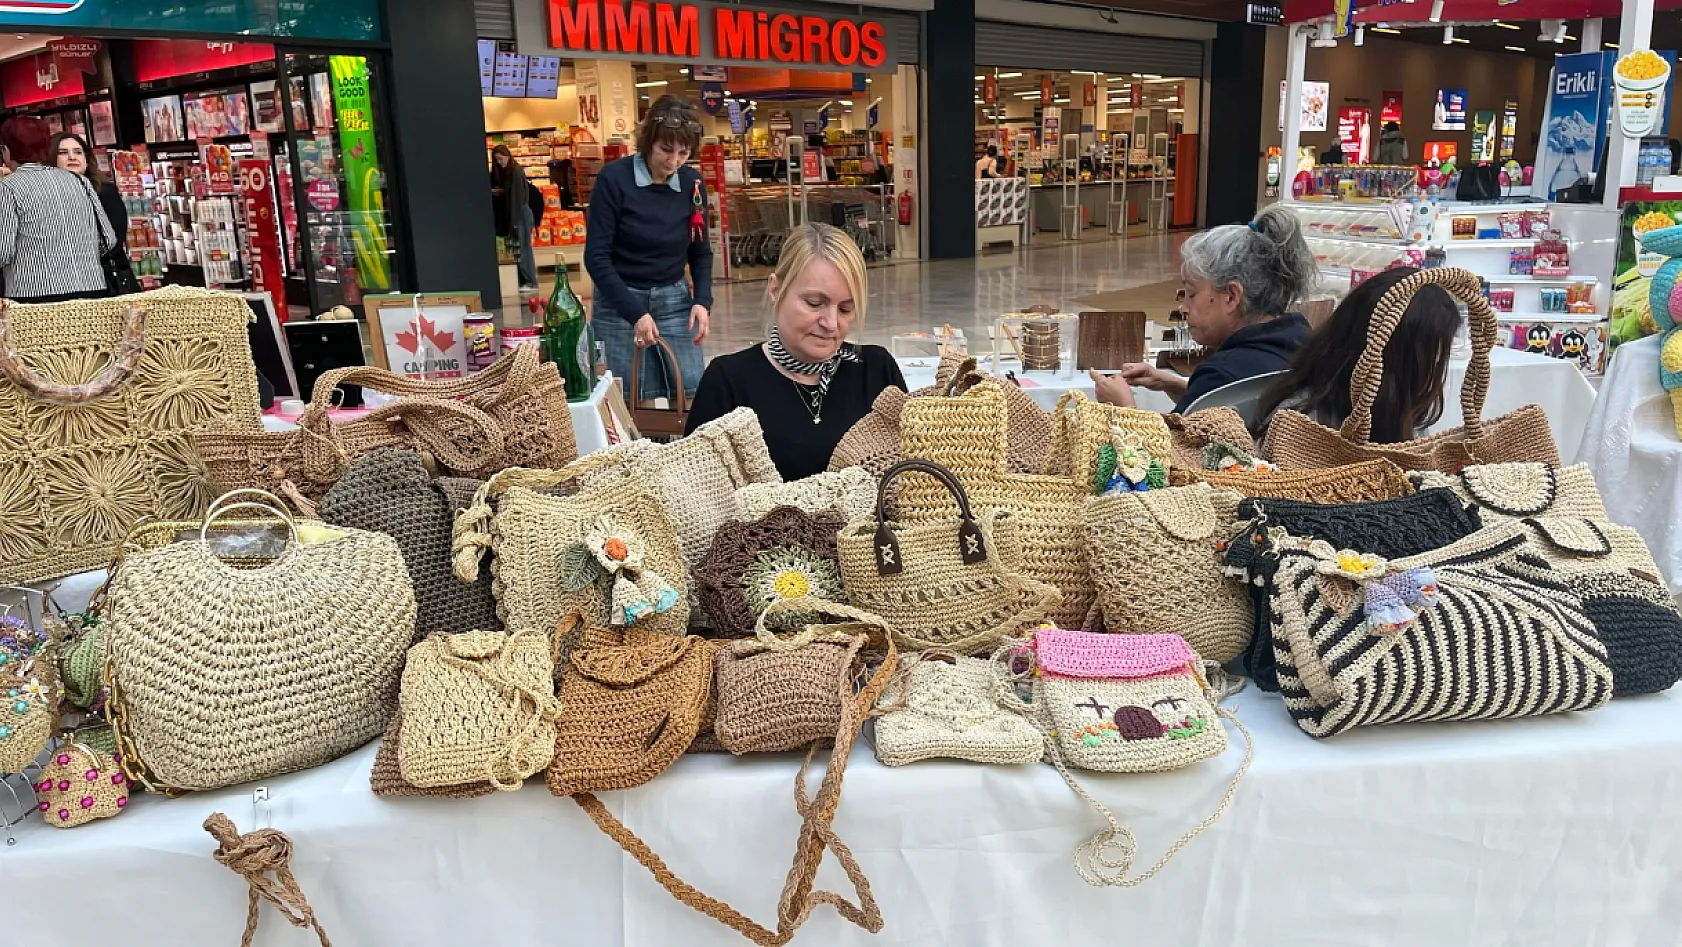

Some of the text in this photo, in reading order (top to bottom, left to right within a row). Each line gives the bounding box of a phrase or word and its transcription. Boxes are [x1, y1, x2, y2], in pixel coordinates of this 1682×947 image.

[547, 0, 887, 67] MMM MiGROS
[338, 77, 363, 87] LOOK
[1556, 71, 1596, 95] Erikli
[339, 87, 365, 98] GOOD
